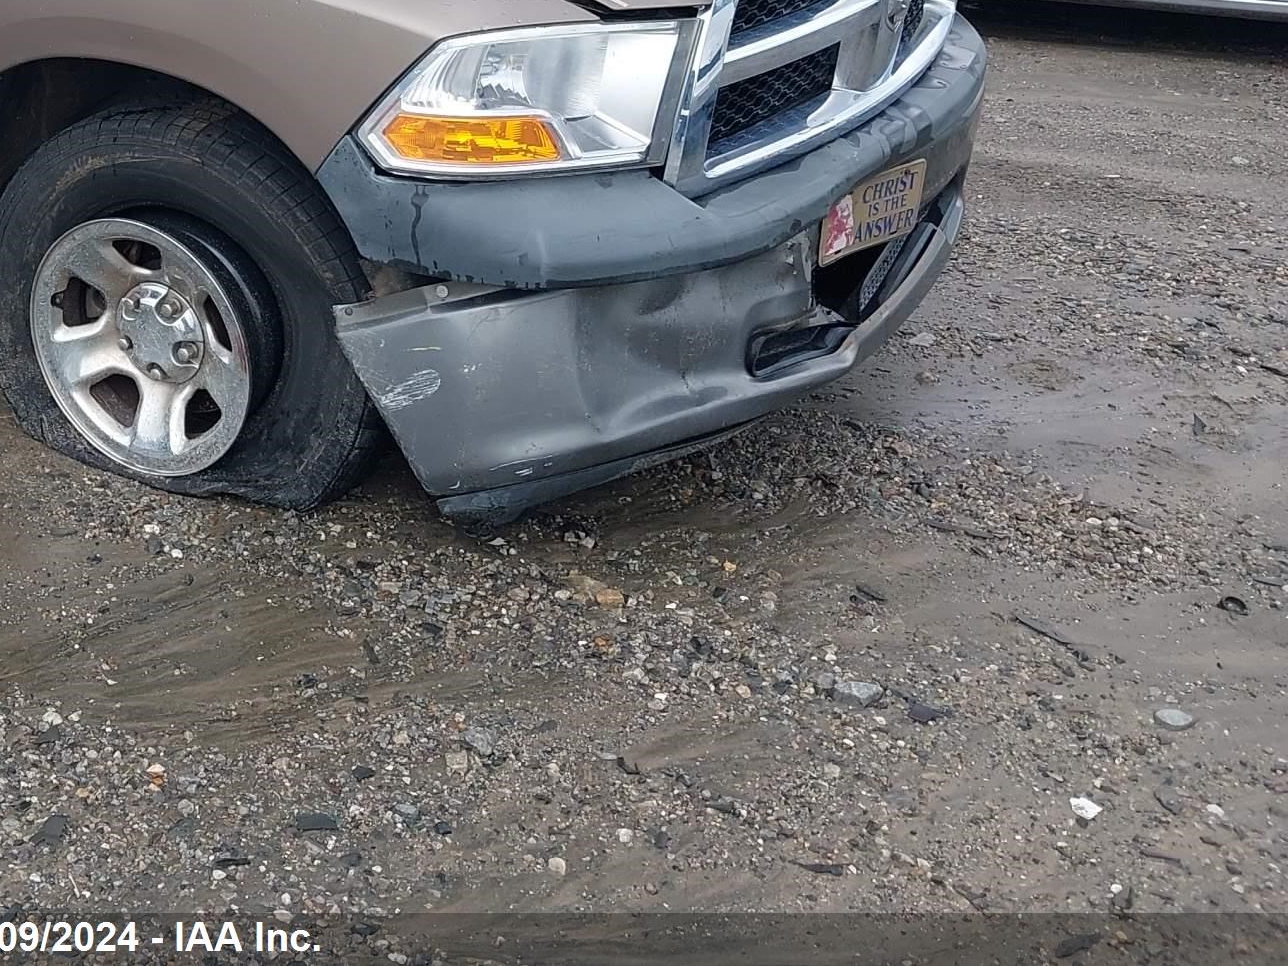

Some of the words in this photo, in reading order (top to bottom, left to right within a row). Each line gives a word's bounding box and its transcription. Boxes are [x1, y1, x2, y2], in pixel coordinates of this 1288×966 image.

[862, 171, 918, 204] CHRIST
[867, 202, 879, 218] IS
[884, 193, 907, 213] THE
[854, 208, 914, 243] ANSWER
